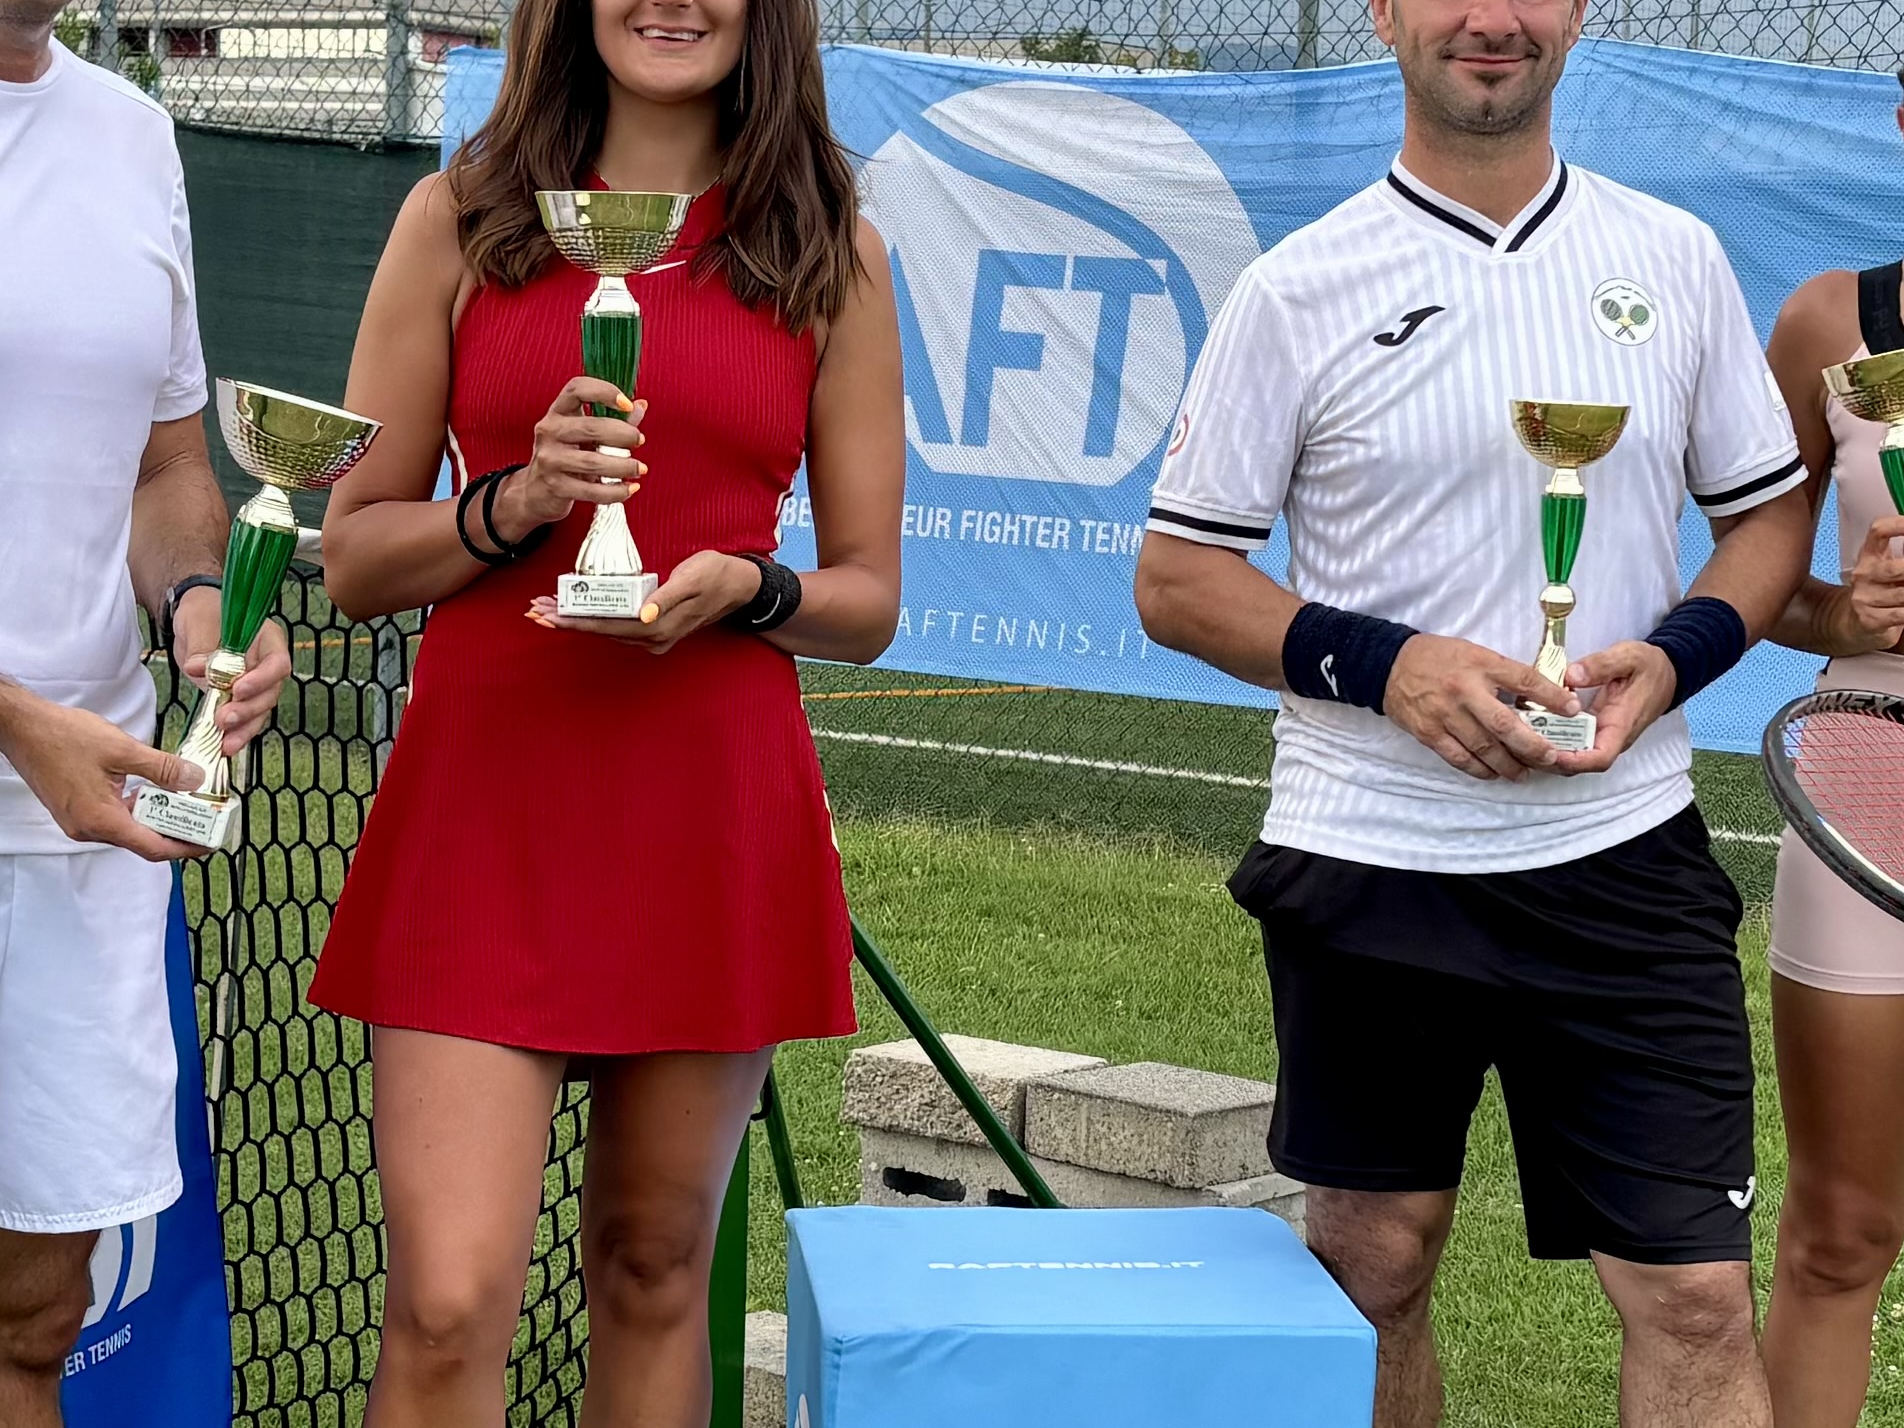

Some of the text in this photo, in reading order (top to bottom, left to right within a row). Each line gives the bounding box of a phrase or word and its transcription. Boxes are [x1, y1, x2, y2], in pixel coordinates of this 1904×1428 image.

[890, 243, 1167, 459] FT
[959, 509, 1071, 551] FIGHTER
[1080, 519, 1145, 556] TENN
[897, 607, 1149, 660] AFTENNIS.IT
[87, 1323, 131, 1365] TENNIS
